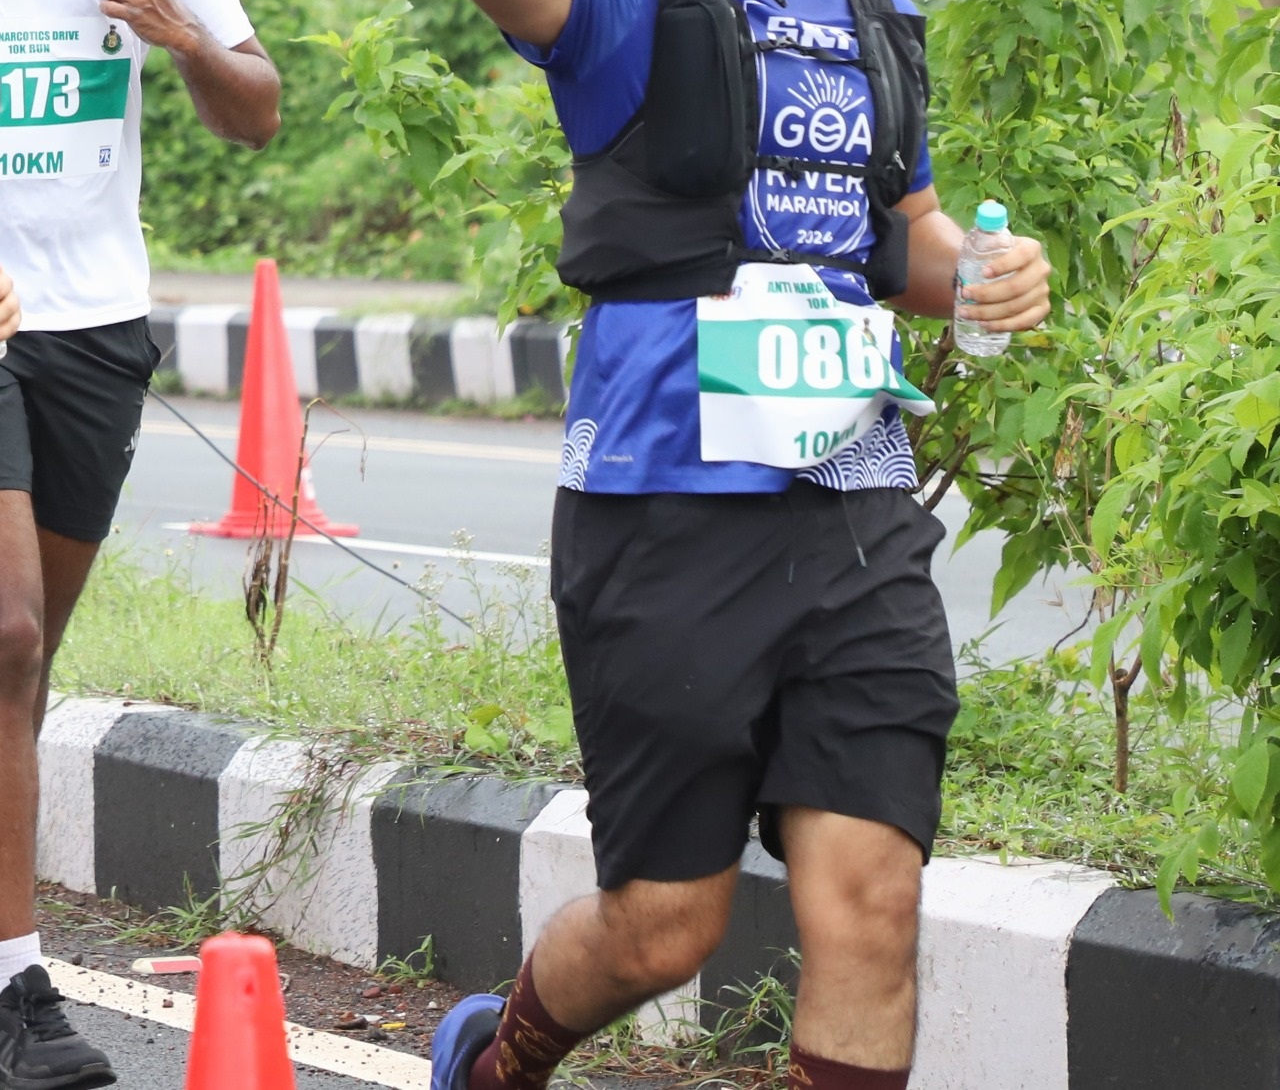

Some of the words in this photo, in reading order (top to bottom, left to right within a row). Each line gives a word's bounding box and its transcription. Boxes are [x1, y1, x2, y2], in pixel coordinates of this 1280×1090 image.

[52, 30, 80, 42] DRIVE
[8, 44, 27, 55] 10K
[29, 44, 51, 54] RUN
[773, 105, 873, 156] GOA
[767, 281, 793, 294] ANTI
[807, 298, 830, 310] 10K
